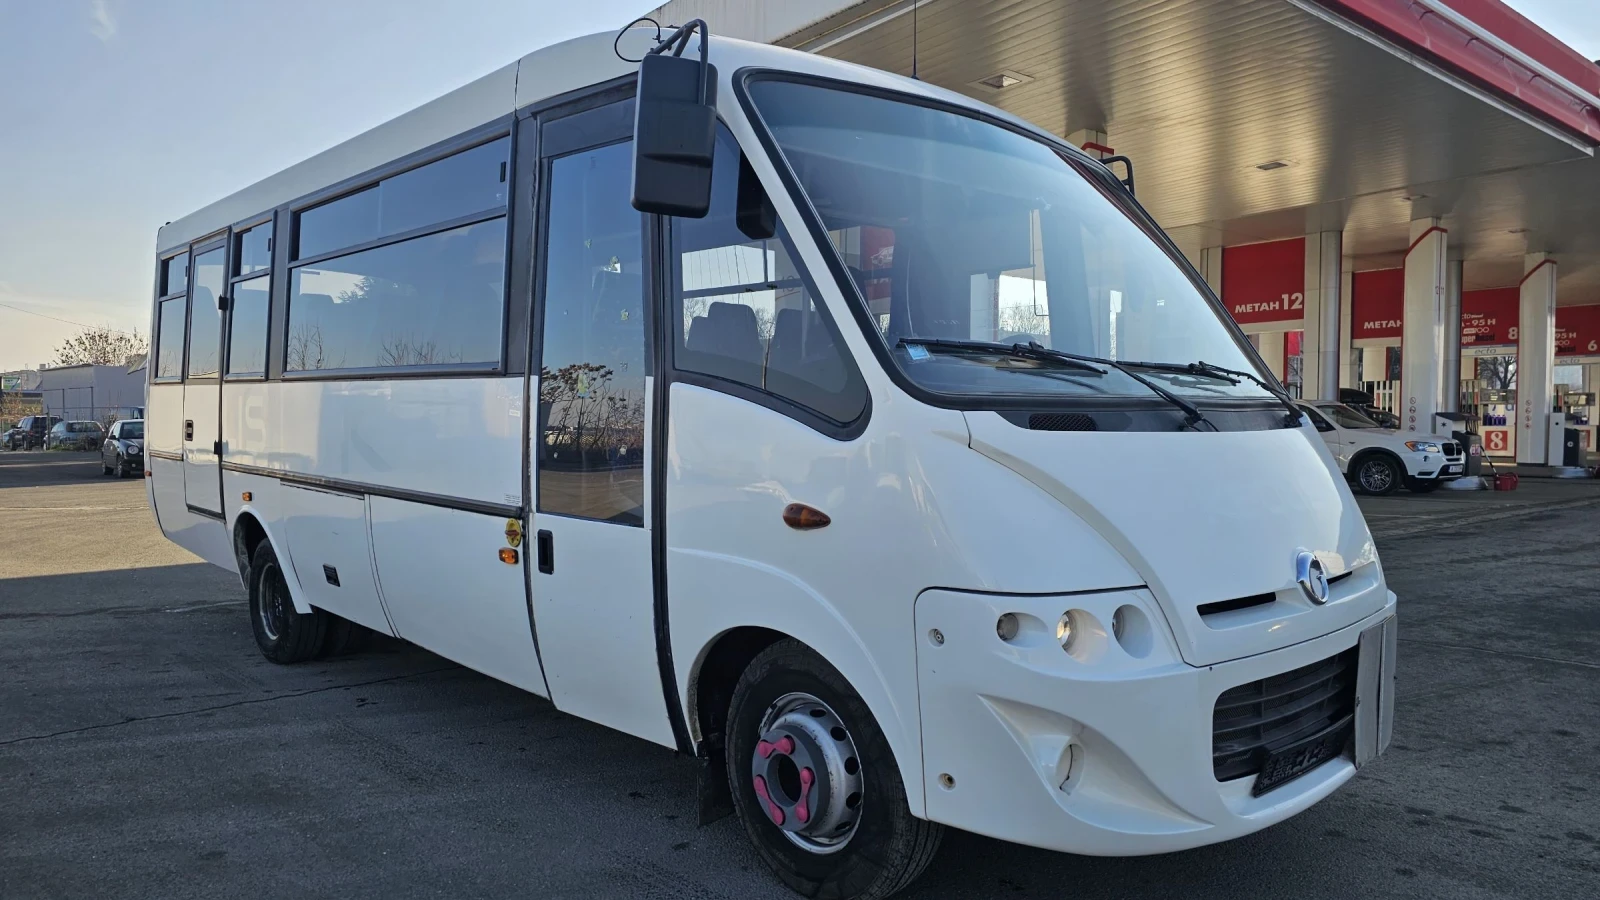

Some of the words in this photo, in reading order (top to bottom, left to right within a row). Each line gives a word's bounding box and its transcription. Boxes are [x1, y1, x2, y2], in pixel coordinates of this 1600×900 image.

[1235, 301, 1279, 313] МЕТАН
[1281, 292, 1304, 310] 12
[1508, 326, 1518, 340] 8
[1587, 339, 1598, 352] 6
[1490, 431, 1503, 450] 8
